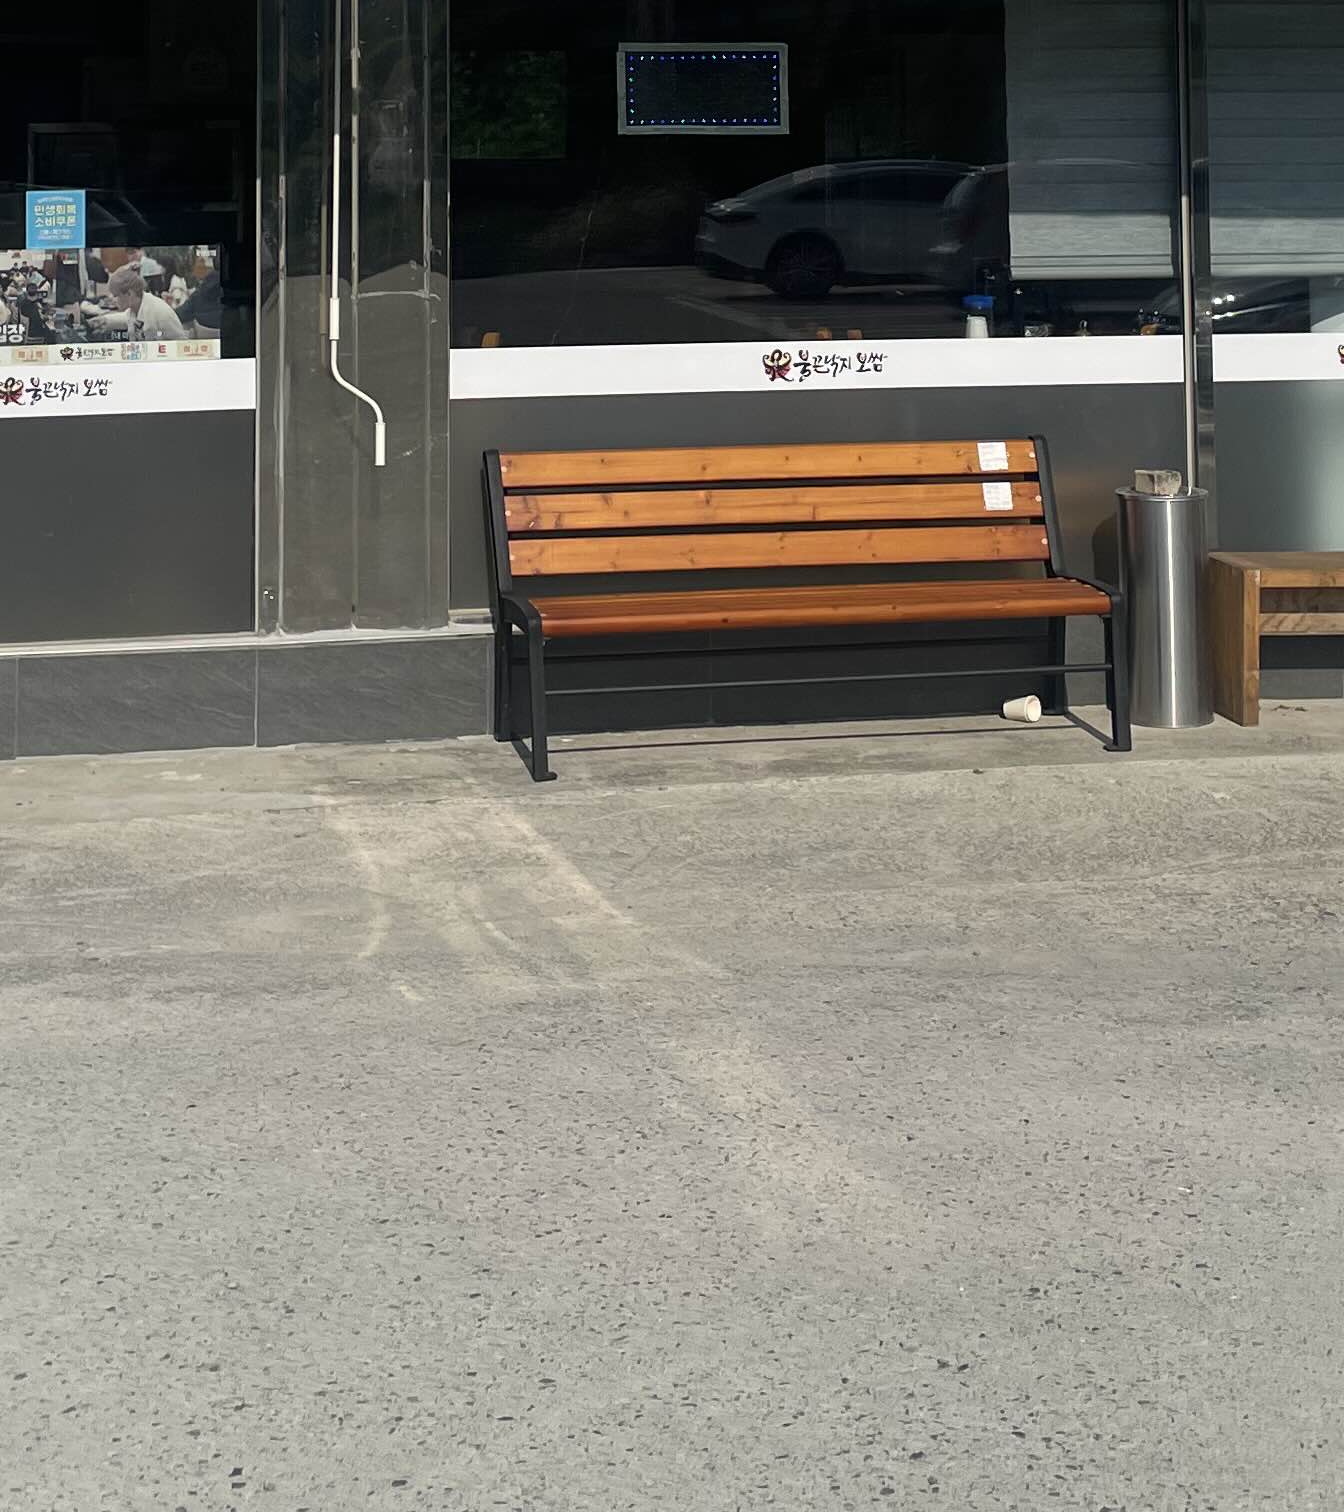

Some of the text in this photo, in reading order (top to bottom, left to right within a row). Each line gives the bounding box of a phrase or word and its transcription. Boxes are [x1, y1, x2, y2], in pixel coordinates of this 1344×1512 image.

[793, 349, 888, 383] 불끈낙지 보쌈
[25, 377, 112, 406] 불끈낙지 보쌈
